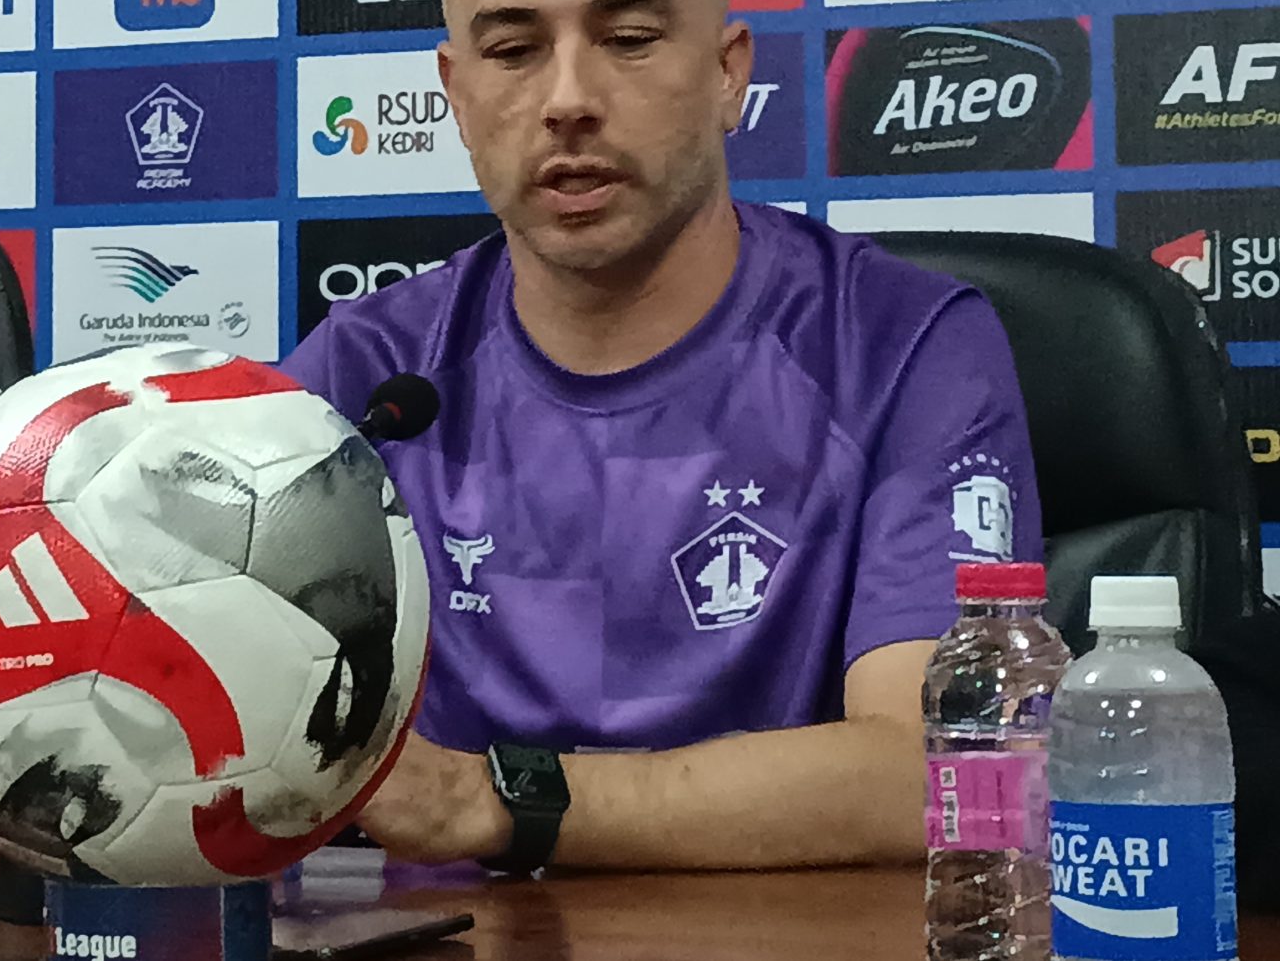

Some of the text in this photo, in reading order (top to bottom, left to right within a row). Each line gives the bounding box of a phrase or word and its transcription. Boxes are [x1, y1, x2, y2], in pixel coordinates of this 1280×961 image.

[378, 91, 449, 125] RSUD
[873, 73, 1038, 134] Akeo
[1232, 236, 1280, 266] SU
[80, 312, 210, 330] Garuda Indonesia
[1051, 832, 1168, 867] OCARI
[1050, 863, 1153, 897] WEAT
[54, 926, 137, 961] League
